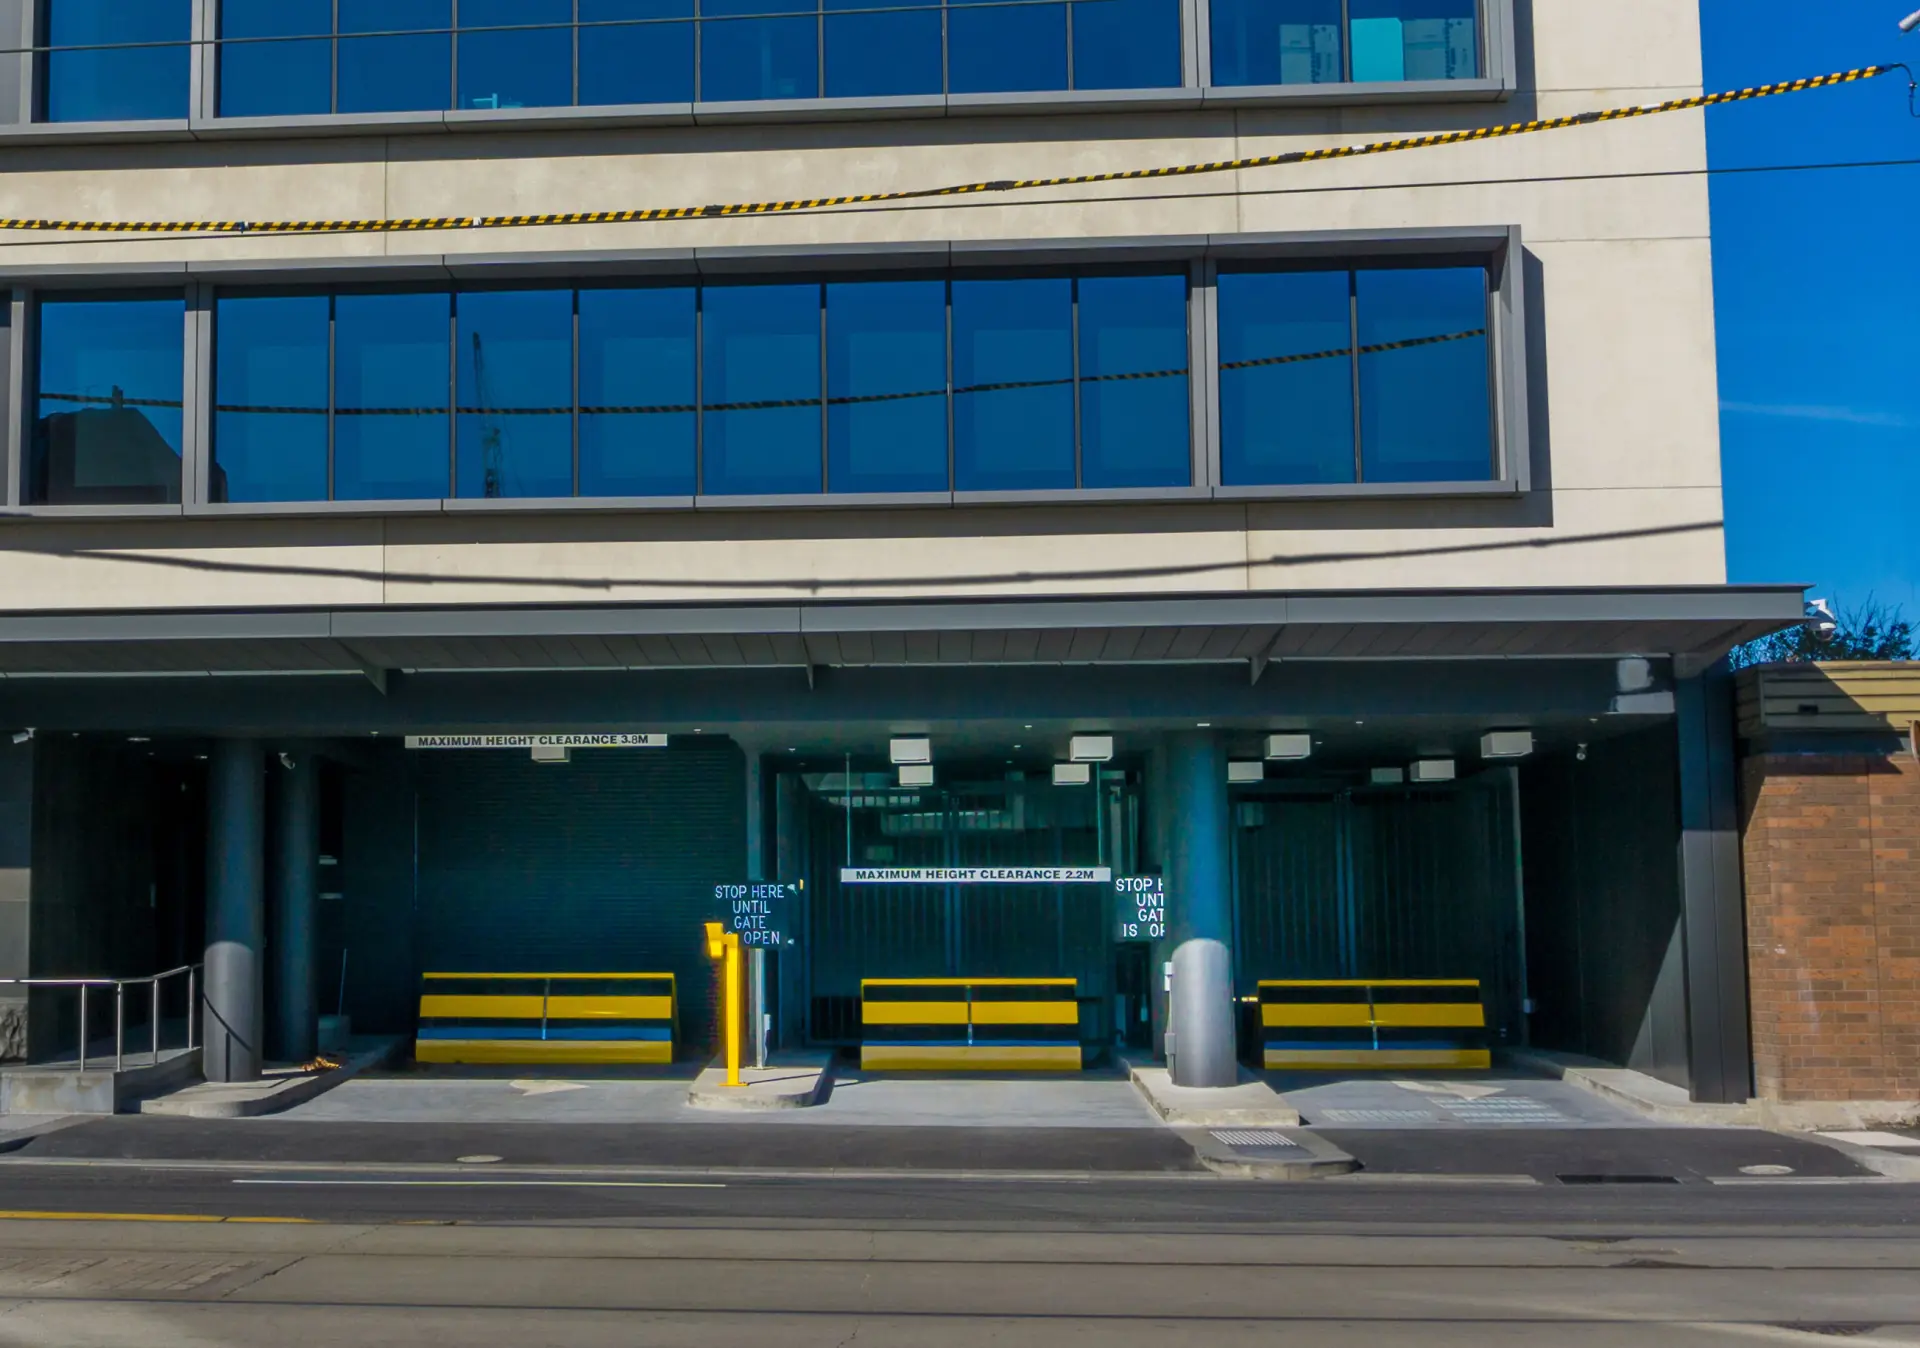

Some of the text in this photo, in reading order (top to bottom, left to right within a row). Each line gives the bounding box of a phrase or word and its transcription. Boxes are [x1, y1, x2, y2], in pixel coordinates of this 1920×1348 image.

[418, 734, 649, 747] MAXIMUM HEIGHT CLEARANCE 3.8M
[855, 869, 1094, 880] MAXIMUM HEIGHT CLEARANCE 2.2M
[1115, 877, 1153, 892] STOP
[715, 885, 785, 899] STOP HERE
[732, 900, 771, 914] UNTIL
[1136, 893, 1164, 907] UNT
[1137, 908, 1165, 922] GAT
[734, 916, 767, 929] GATE
[1123, 923, 1138, 937] IS
[743, 931, 780, 945] OPEN
